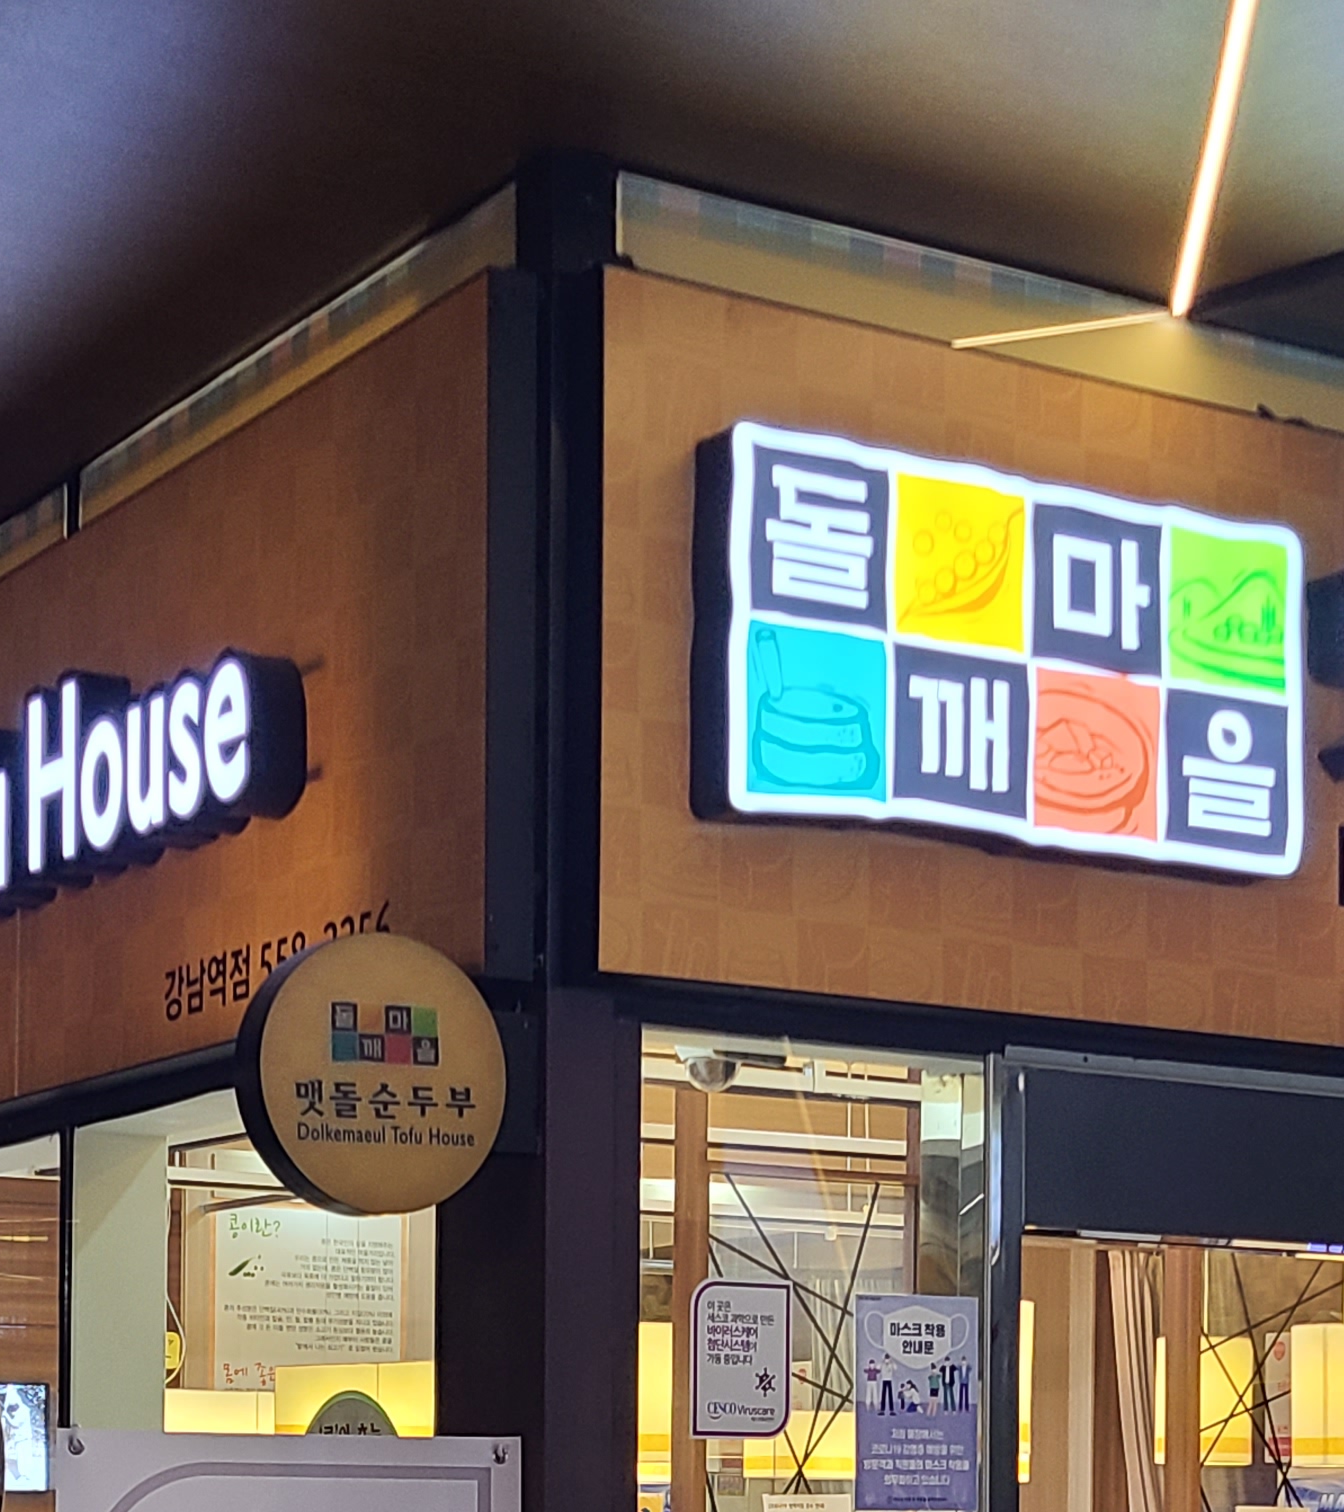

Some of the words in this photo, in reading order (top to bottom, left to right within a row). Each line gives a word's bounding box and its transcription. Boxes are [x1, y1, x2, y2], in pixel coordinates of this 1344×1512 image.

[25, 654, 250, 876] House
[163, 944, 251, 1022] 강남역점
[294, 1078, 477, 1120] 맷돌순두부
[296, 1122, 387, 1145] Dolkemaeul
[390, 1125, 423, 1146] Tofu
[428, 1128, 476, 1148] House
[227, 1212, 282, 1240] 콩이란?
[889, 1322, 923, 1337] 마스크
[924, 1323, 946, 1339] 착용
[901, 1339, 935, 1356] 안내문
